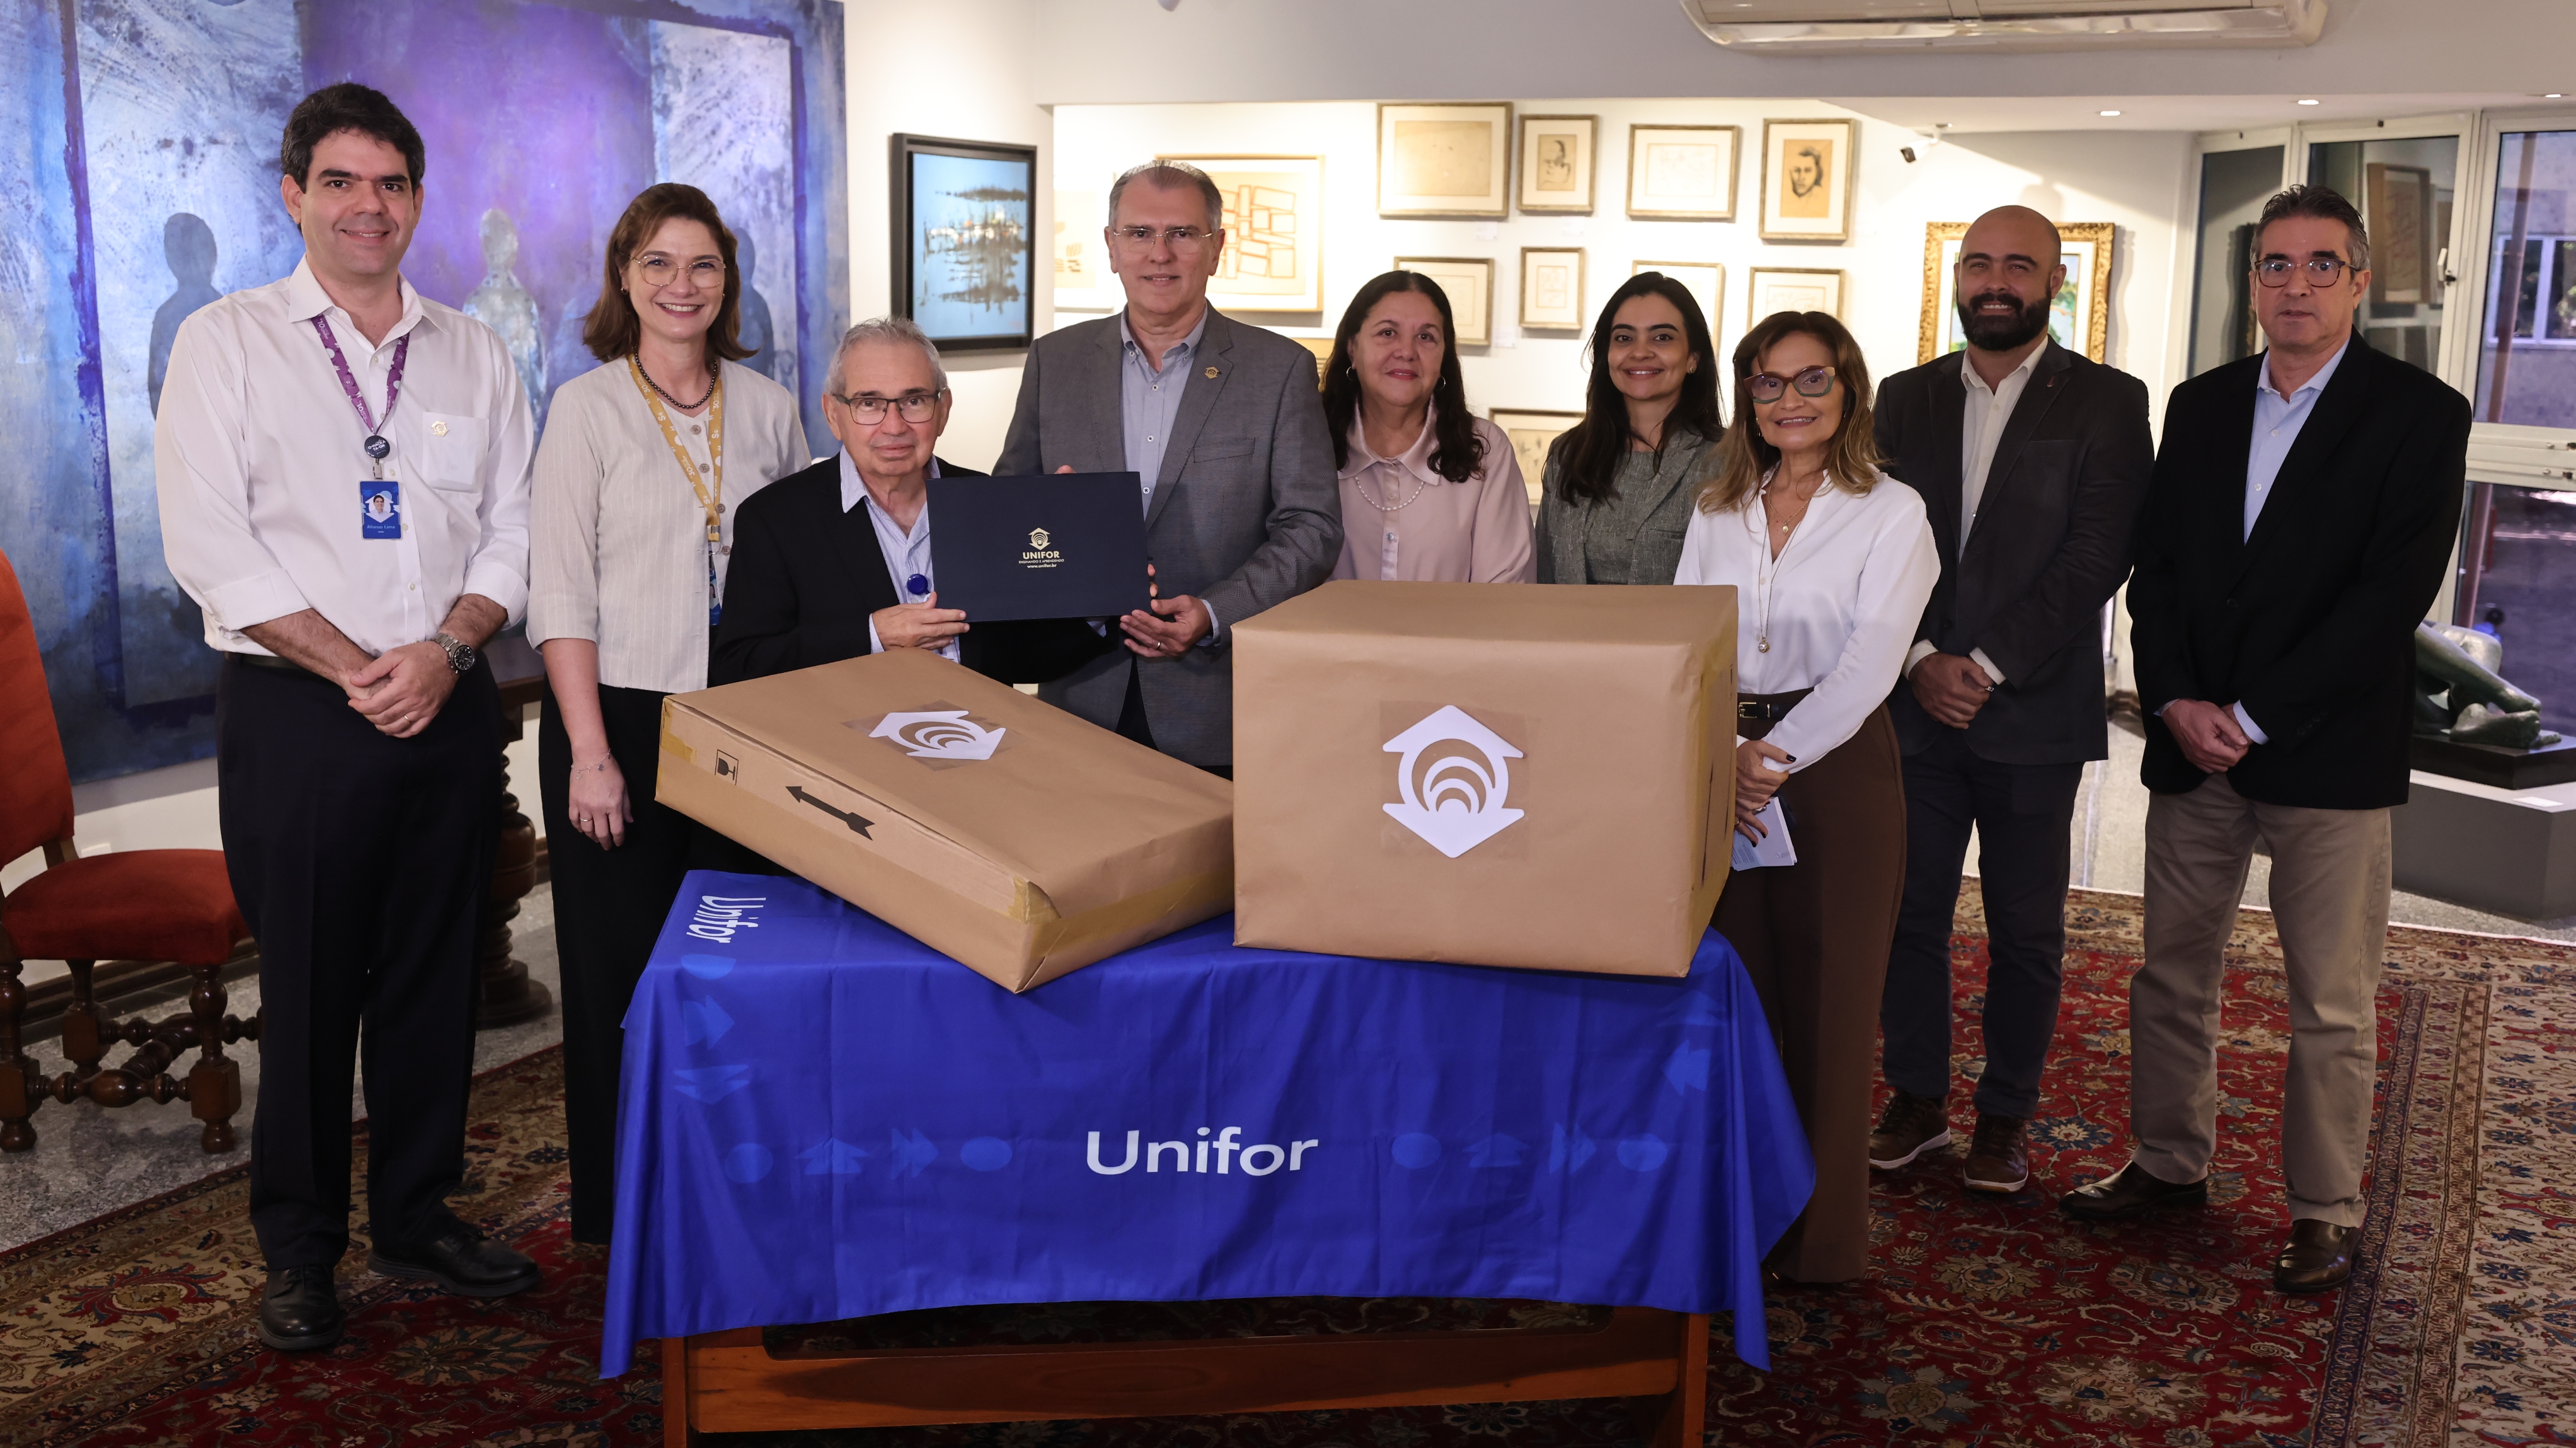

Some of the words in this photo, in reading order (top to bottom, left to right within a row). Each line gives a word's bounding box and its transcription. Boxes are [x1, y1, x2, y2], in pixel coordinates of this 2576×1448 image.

[1022, 551, 1060, 560] UNIFOR
[686, 895, 766, 943] Unifor
[1086, 1126, 1319, 1176] Unifor
